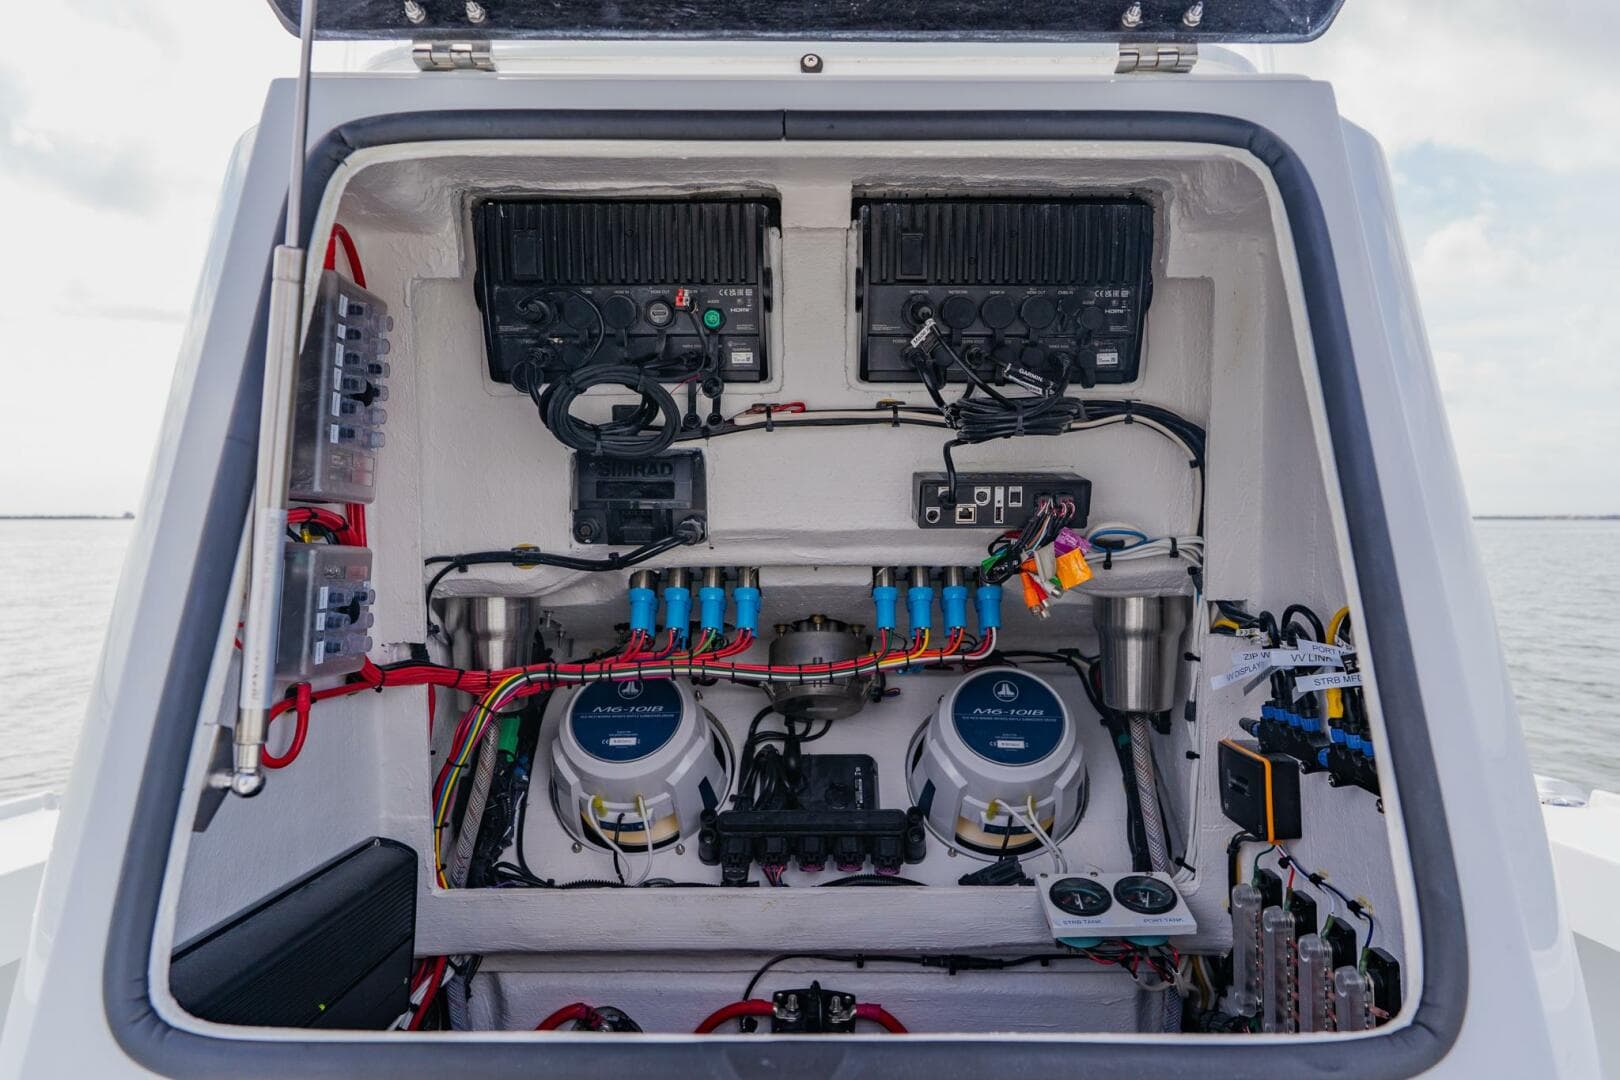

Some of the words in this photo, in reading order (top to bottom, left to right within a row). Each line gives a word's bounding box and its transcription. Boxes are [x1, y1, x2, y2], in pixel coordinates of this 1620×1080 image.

[1019, 368, 1043, 382] GARMIN
[598, 462, 673, 477] SIMRAD
[1312, 645, 1335, 654] PORT
[1313, 676, 1340, 686] STRB
